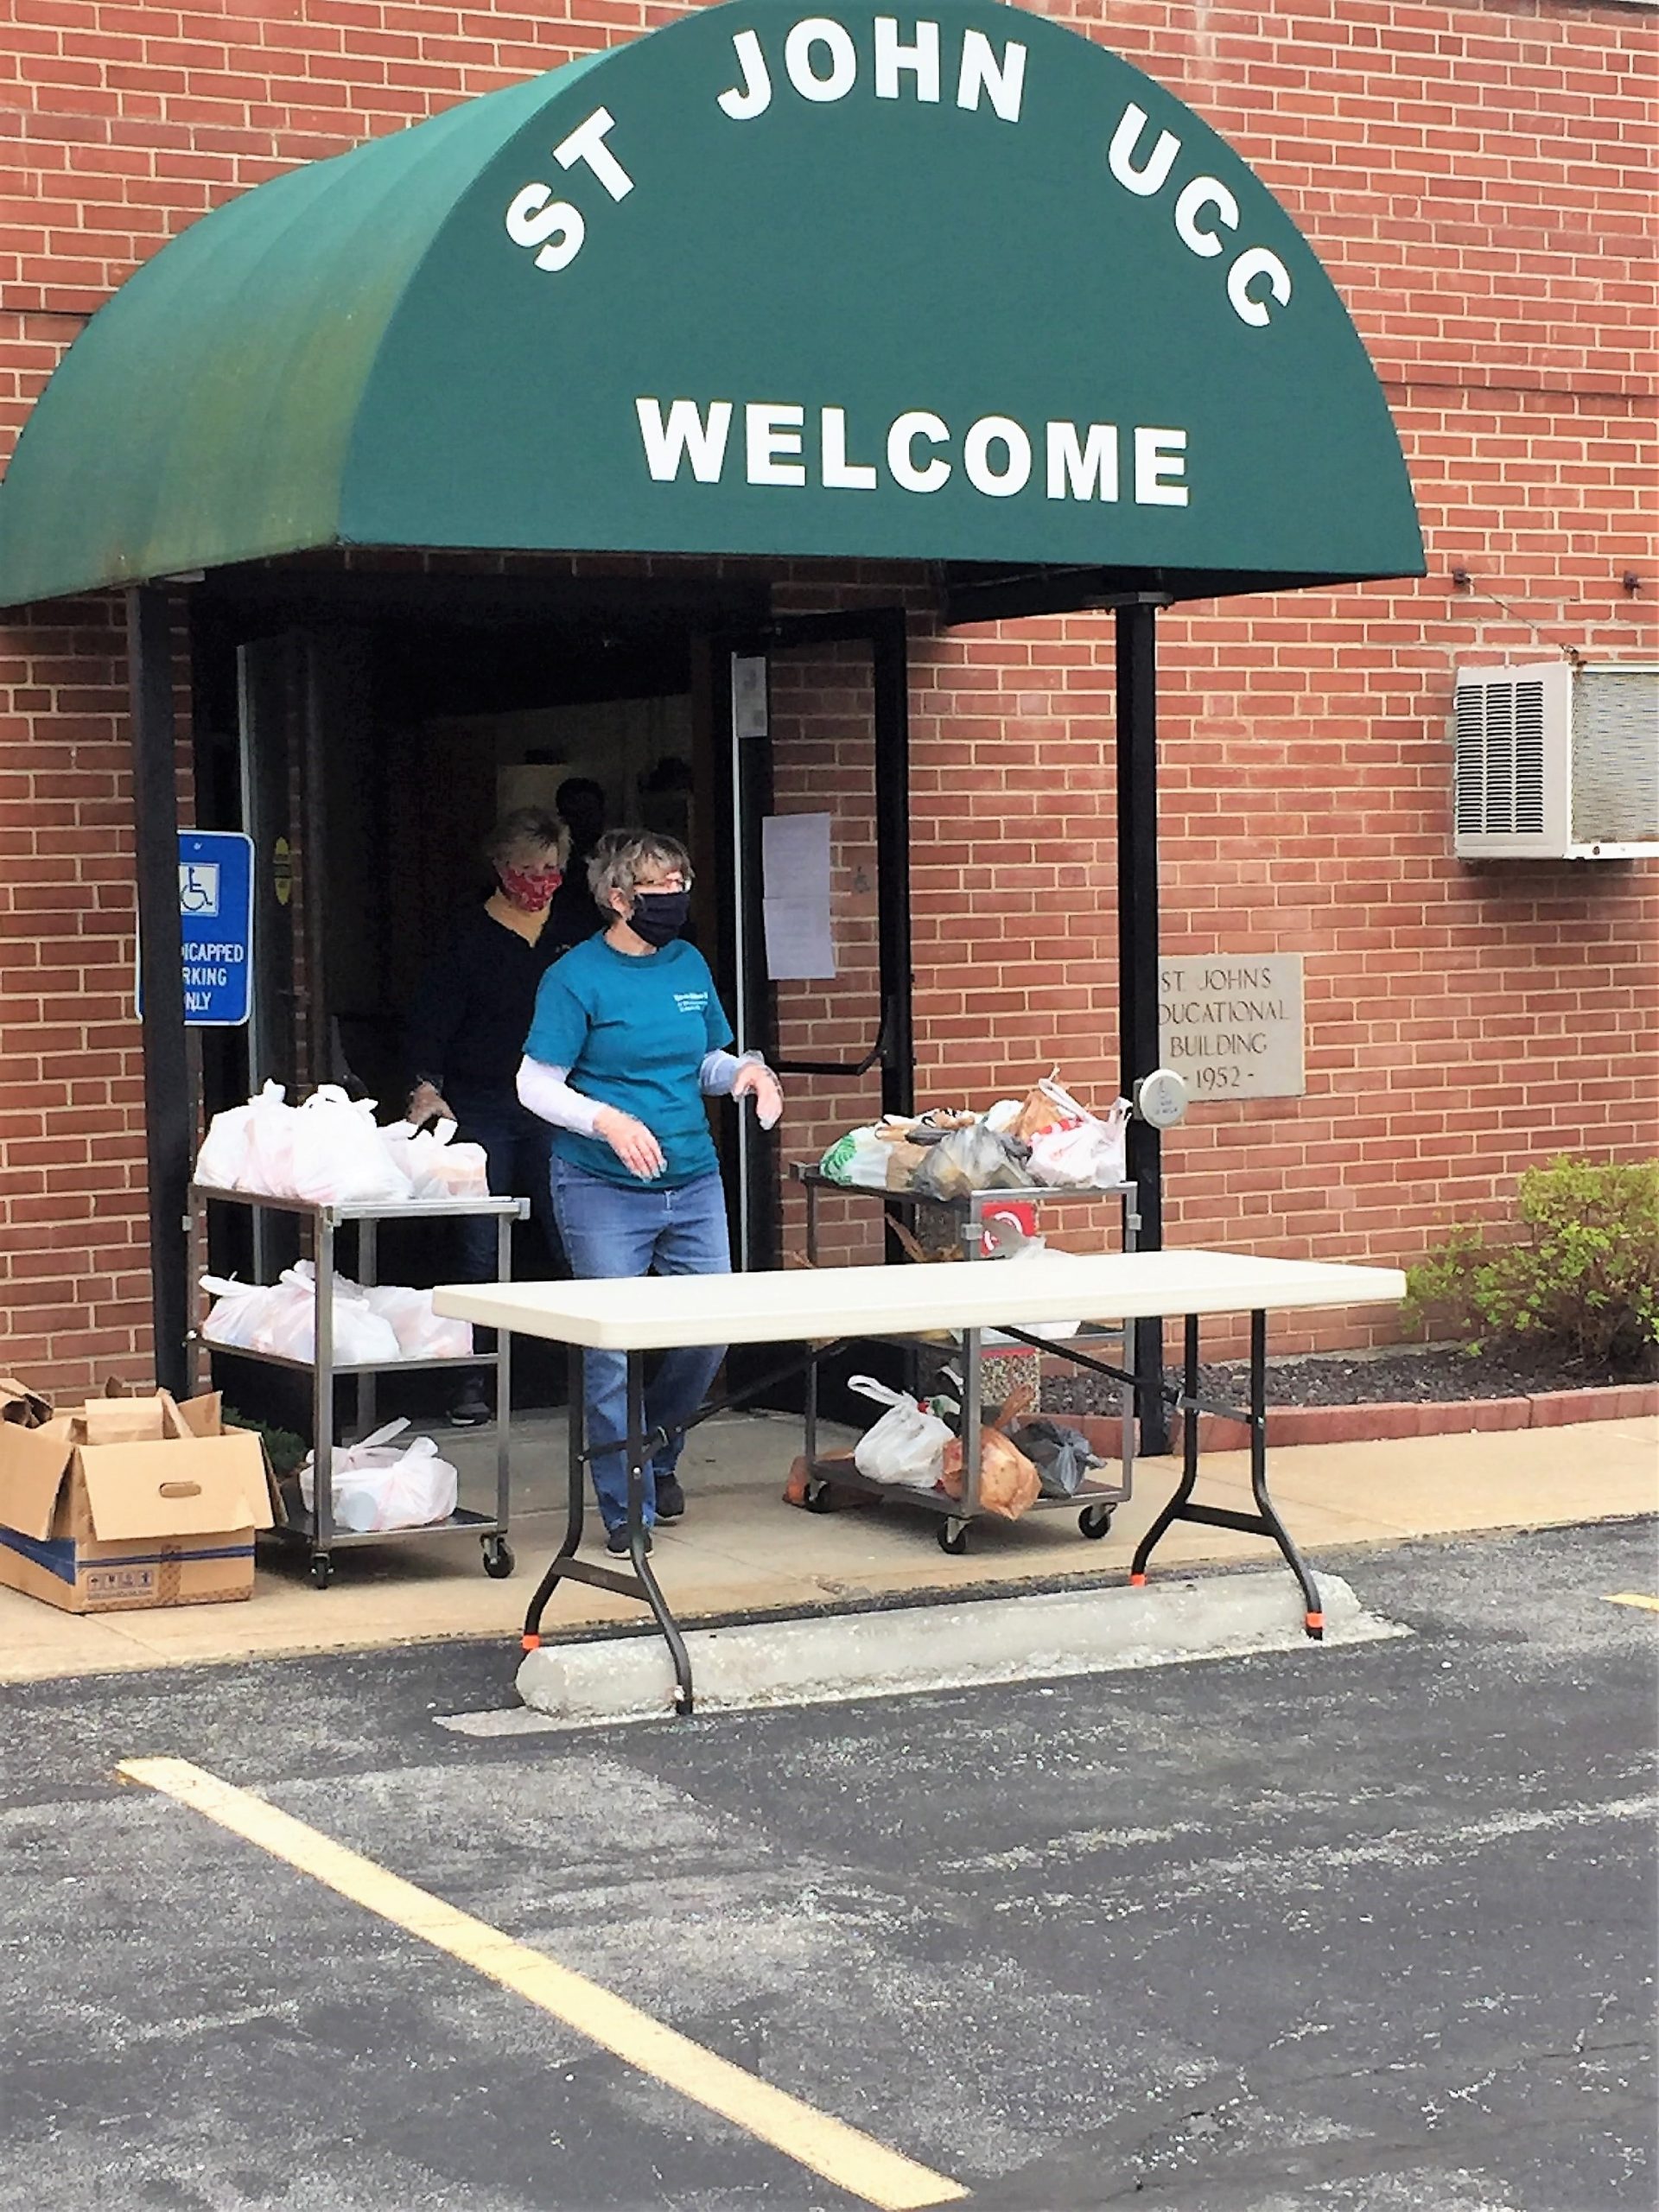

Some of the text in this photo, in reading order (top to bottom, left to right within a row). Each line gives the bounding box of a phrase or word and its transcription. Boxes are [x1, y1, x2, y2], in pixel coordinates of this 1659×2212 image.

[505, 16, 1292, 327] ST JOHN UCC
[634, 397, 1190, 507] WELCOME
[181, 942, 244, 963] ICAPPED
[181, 966, 227, 986] RKING
[184, 990, 212, 1012] NLY
[1158, 999, 1290, 1026] DUCATIONAL
[1170, 1032, 1267, 1057] BUILDING
